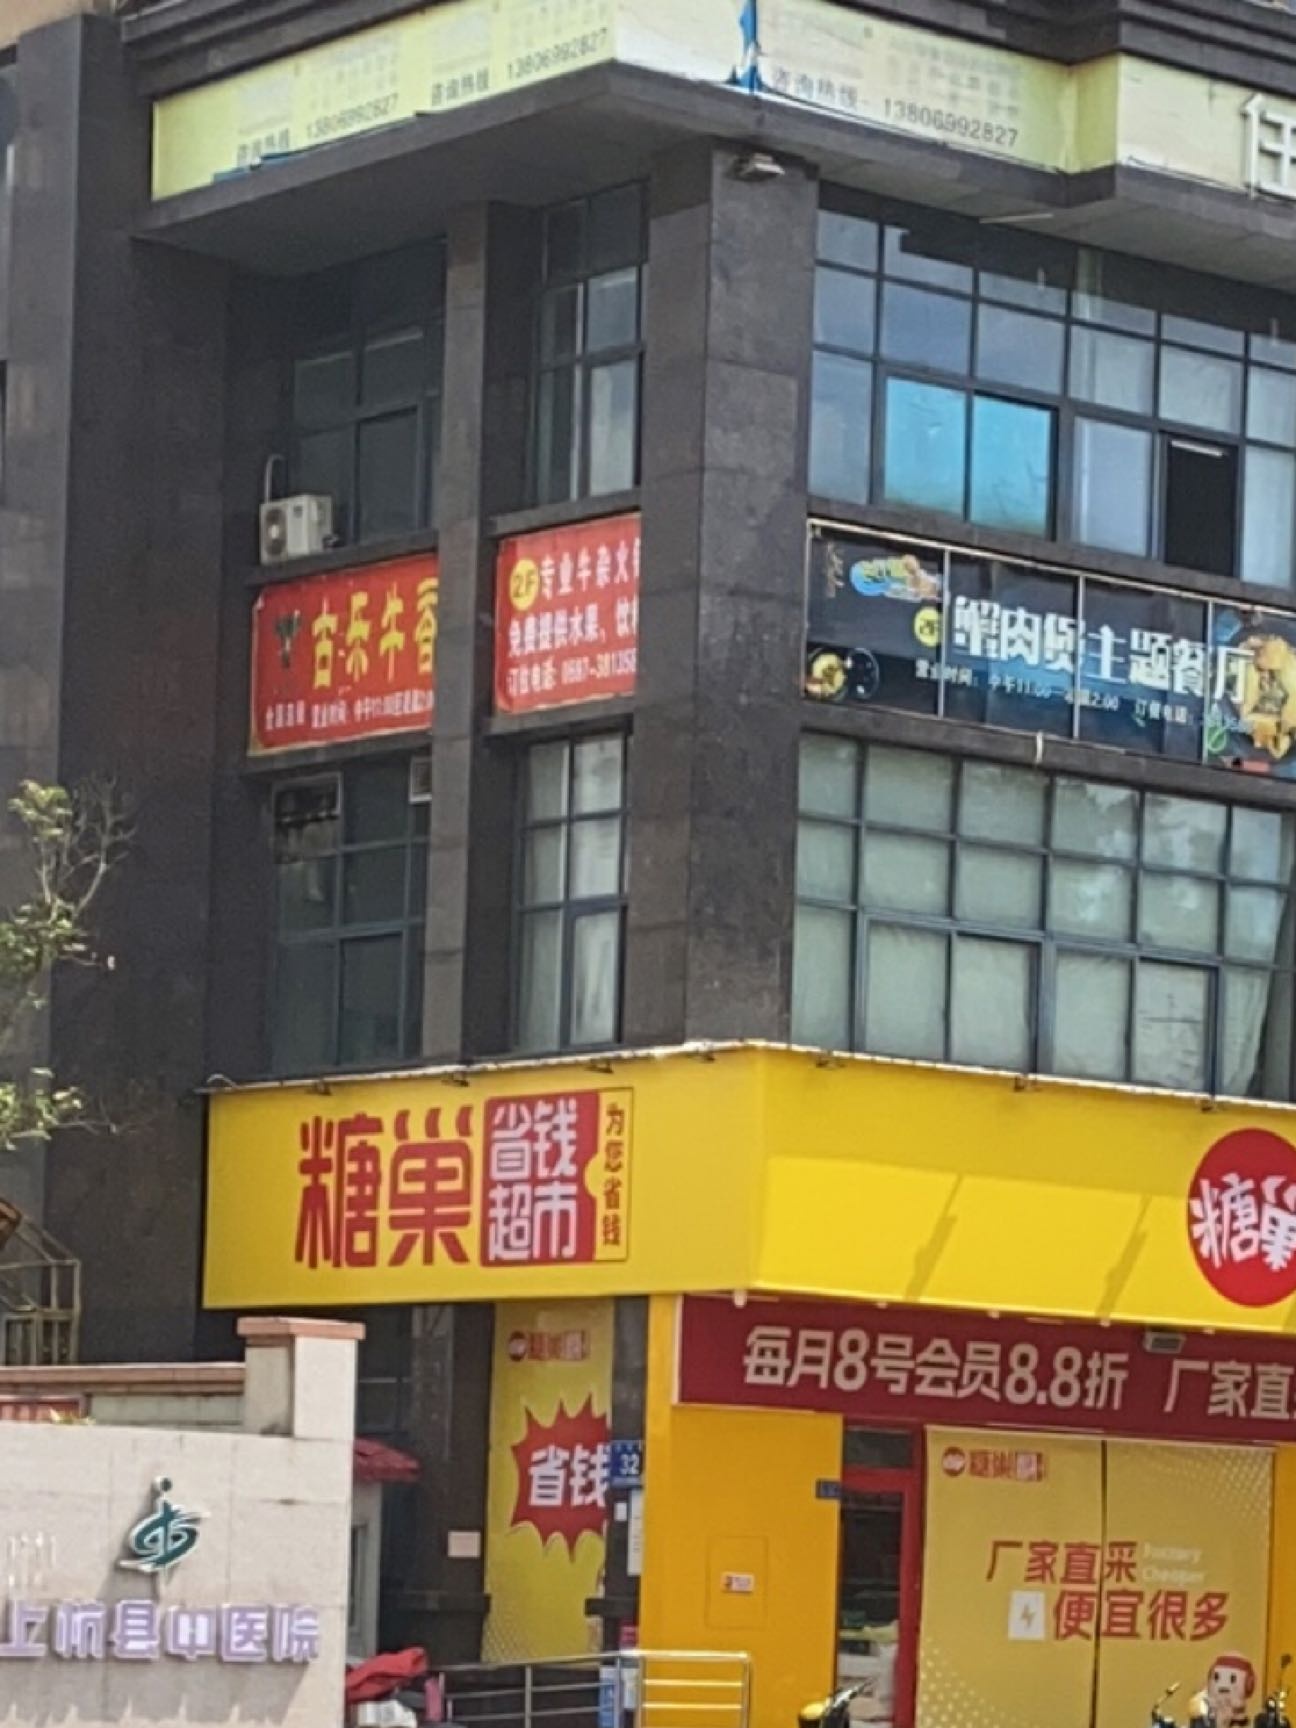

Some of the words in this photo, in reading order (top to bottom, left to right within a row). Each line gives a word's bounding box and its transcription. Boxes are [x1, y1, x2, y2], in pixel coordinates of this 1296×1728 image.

[490, 1097, 579, 1181] 省钱
[294, 1106, 474, 1269] 糖巢
[488, 1181, 579, 1262] 超市
[744, 1324, 1129, 1411] 每月8号会员8.8折
[529, 1445, 611, 1507] 省钱
[987, 1539, 1138, 1584] 厂家直采
[1053, 1590, 1230, 1641] 便宜很多
